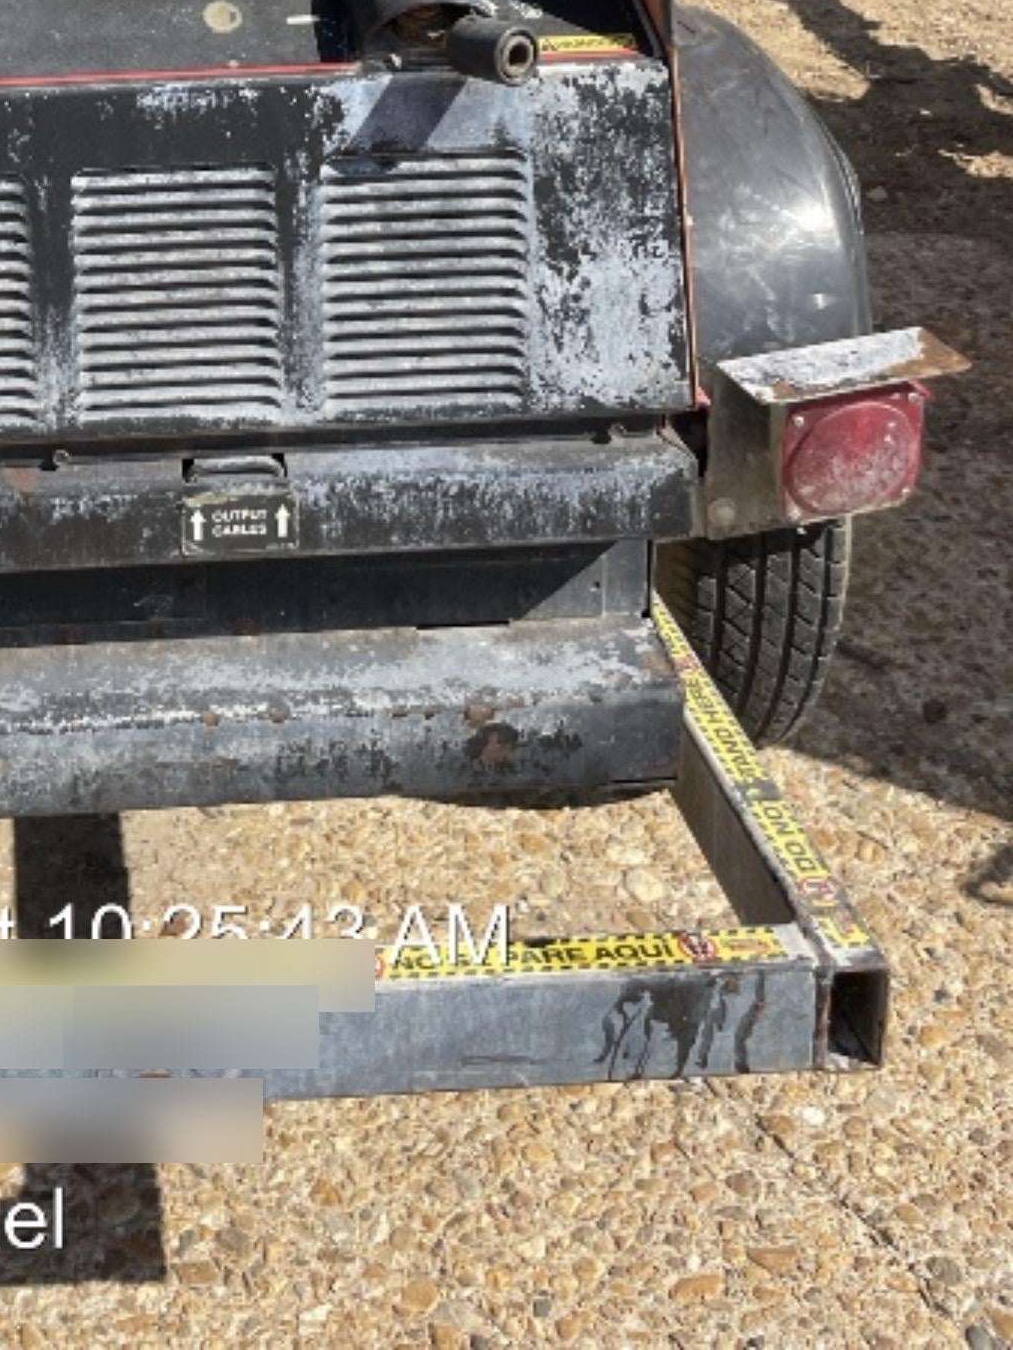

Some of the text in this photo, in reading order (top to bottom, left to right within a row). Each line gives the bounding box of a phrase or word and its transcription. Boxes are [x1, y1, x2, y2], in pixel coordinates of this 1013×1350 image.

[211, 508, 268, 523] OUTPUT
[211, 523, 268, 538] CABLES
[687, 678, 727, 725] HERE
[784, 841, 817, 873] DO
